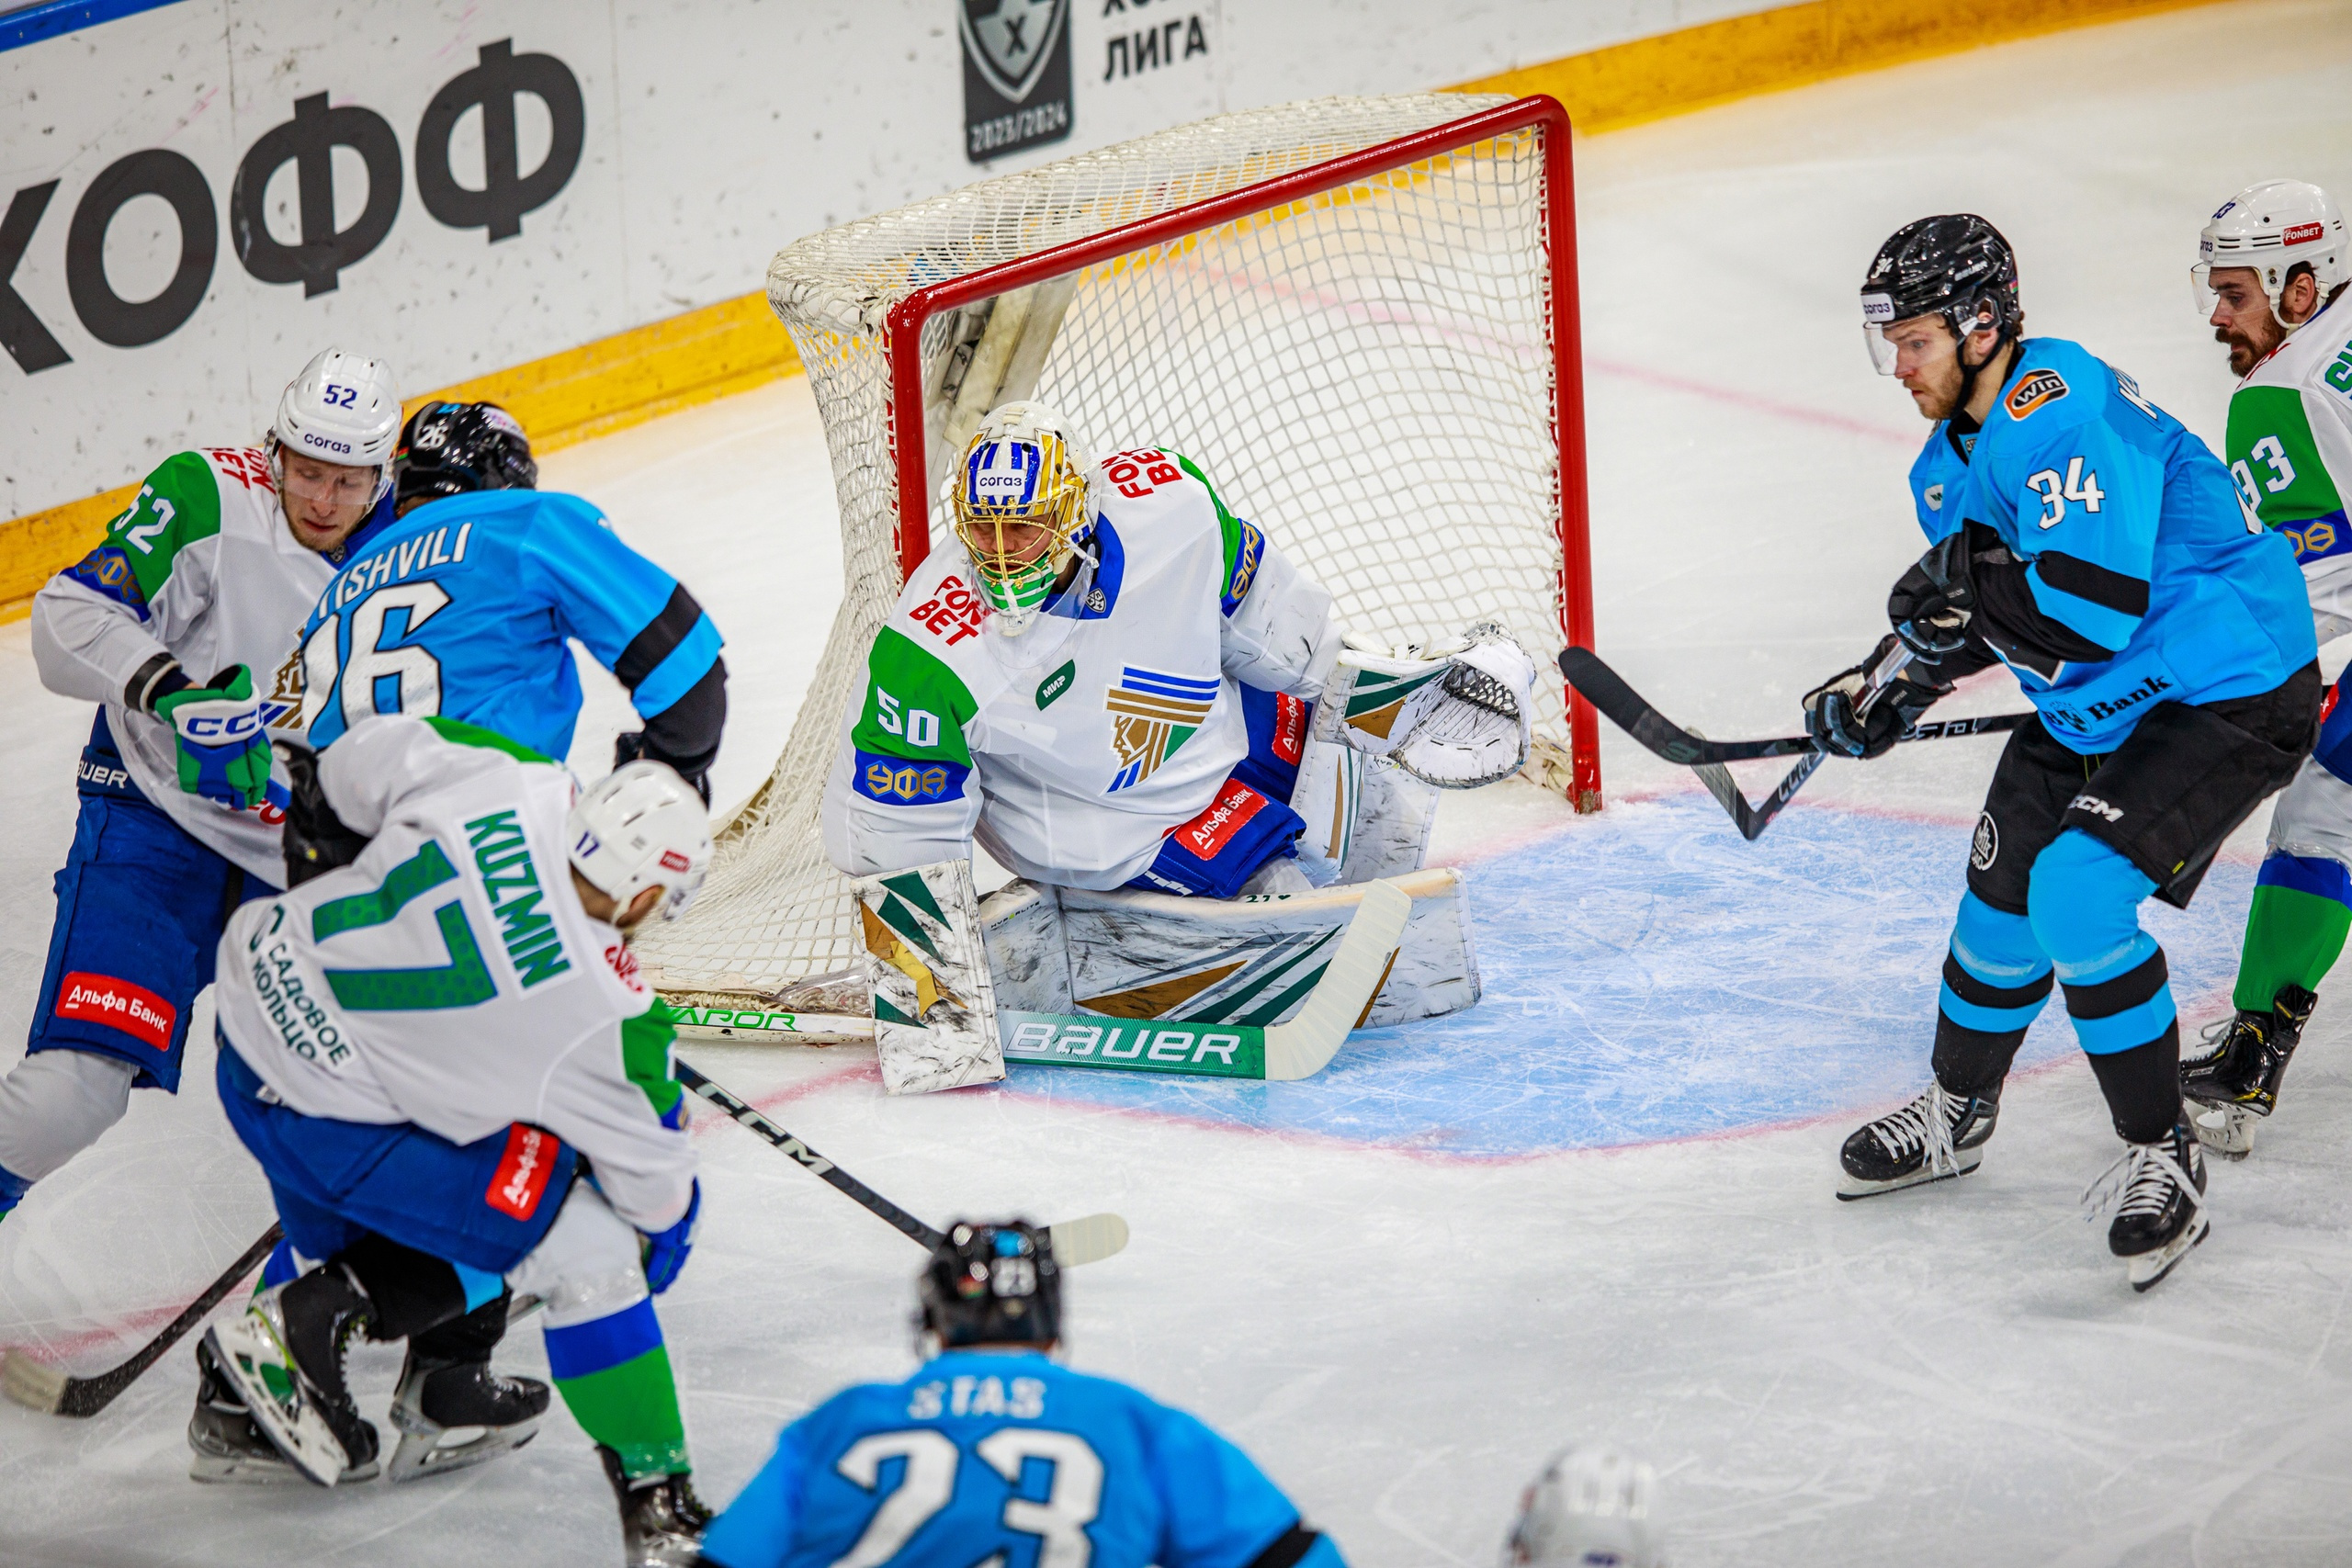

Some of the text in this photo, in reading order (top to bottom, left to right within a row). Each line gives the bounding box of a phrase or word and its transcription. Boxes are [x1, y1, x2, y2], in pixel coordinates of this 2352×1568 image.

[1102, 15, 1207, 84] ЛИГА
[970, 101, 1069, 153] 2023/2024
[2284, 226, 2321, 242] FONBET
[323, 384, 358, 410] 52
[304, 432, 352, 455] согаз
[415, 423, 448, 448] 26
[200, 446, 251, 491] ET
[979, 477, 1022, 487] согаз
[2026, 456, 2105, 530] 34
[909, 599, 979, 647] BET
[1042, 675, 1066, 698] МИР
[2084, 675, 2174, 723] Bank
[876, 685, 941, 748] 50
[1283, 695, 1299, 754] Альфа
[77, 761, 129, 789] UER
[1192, 788, 1254, 850] Альфа Банк
[575, 830, 601, 858] 17
[464, 809, 571, 989] KUZMIN
[312, 839, 498, 1011] 17
[65, 984, 167, 1033] Альфа Банк
[268, 942, 352, 1066] САДОВОЕ
[1006, 1021, 1241, 1066] BAUER
[695, 1082, 835, 1177] CCM
[908, 1376, 1046, 1419] STAS
[836, 1427, 1104, 1568] 23
